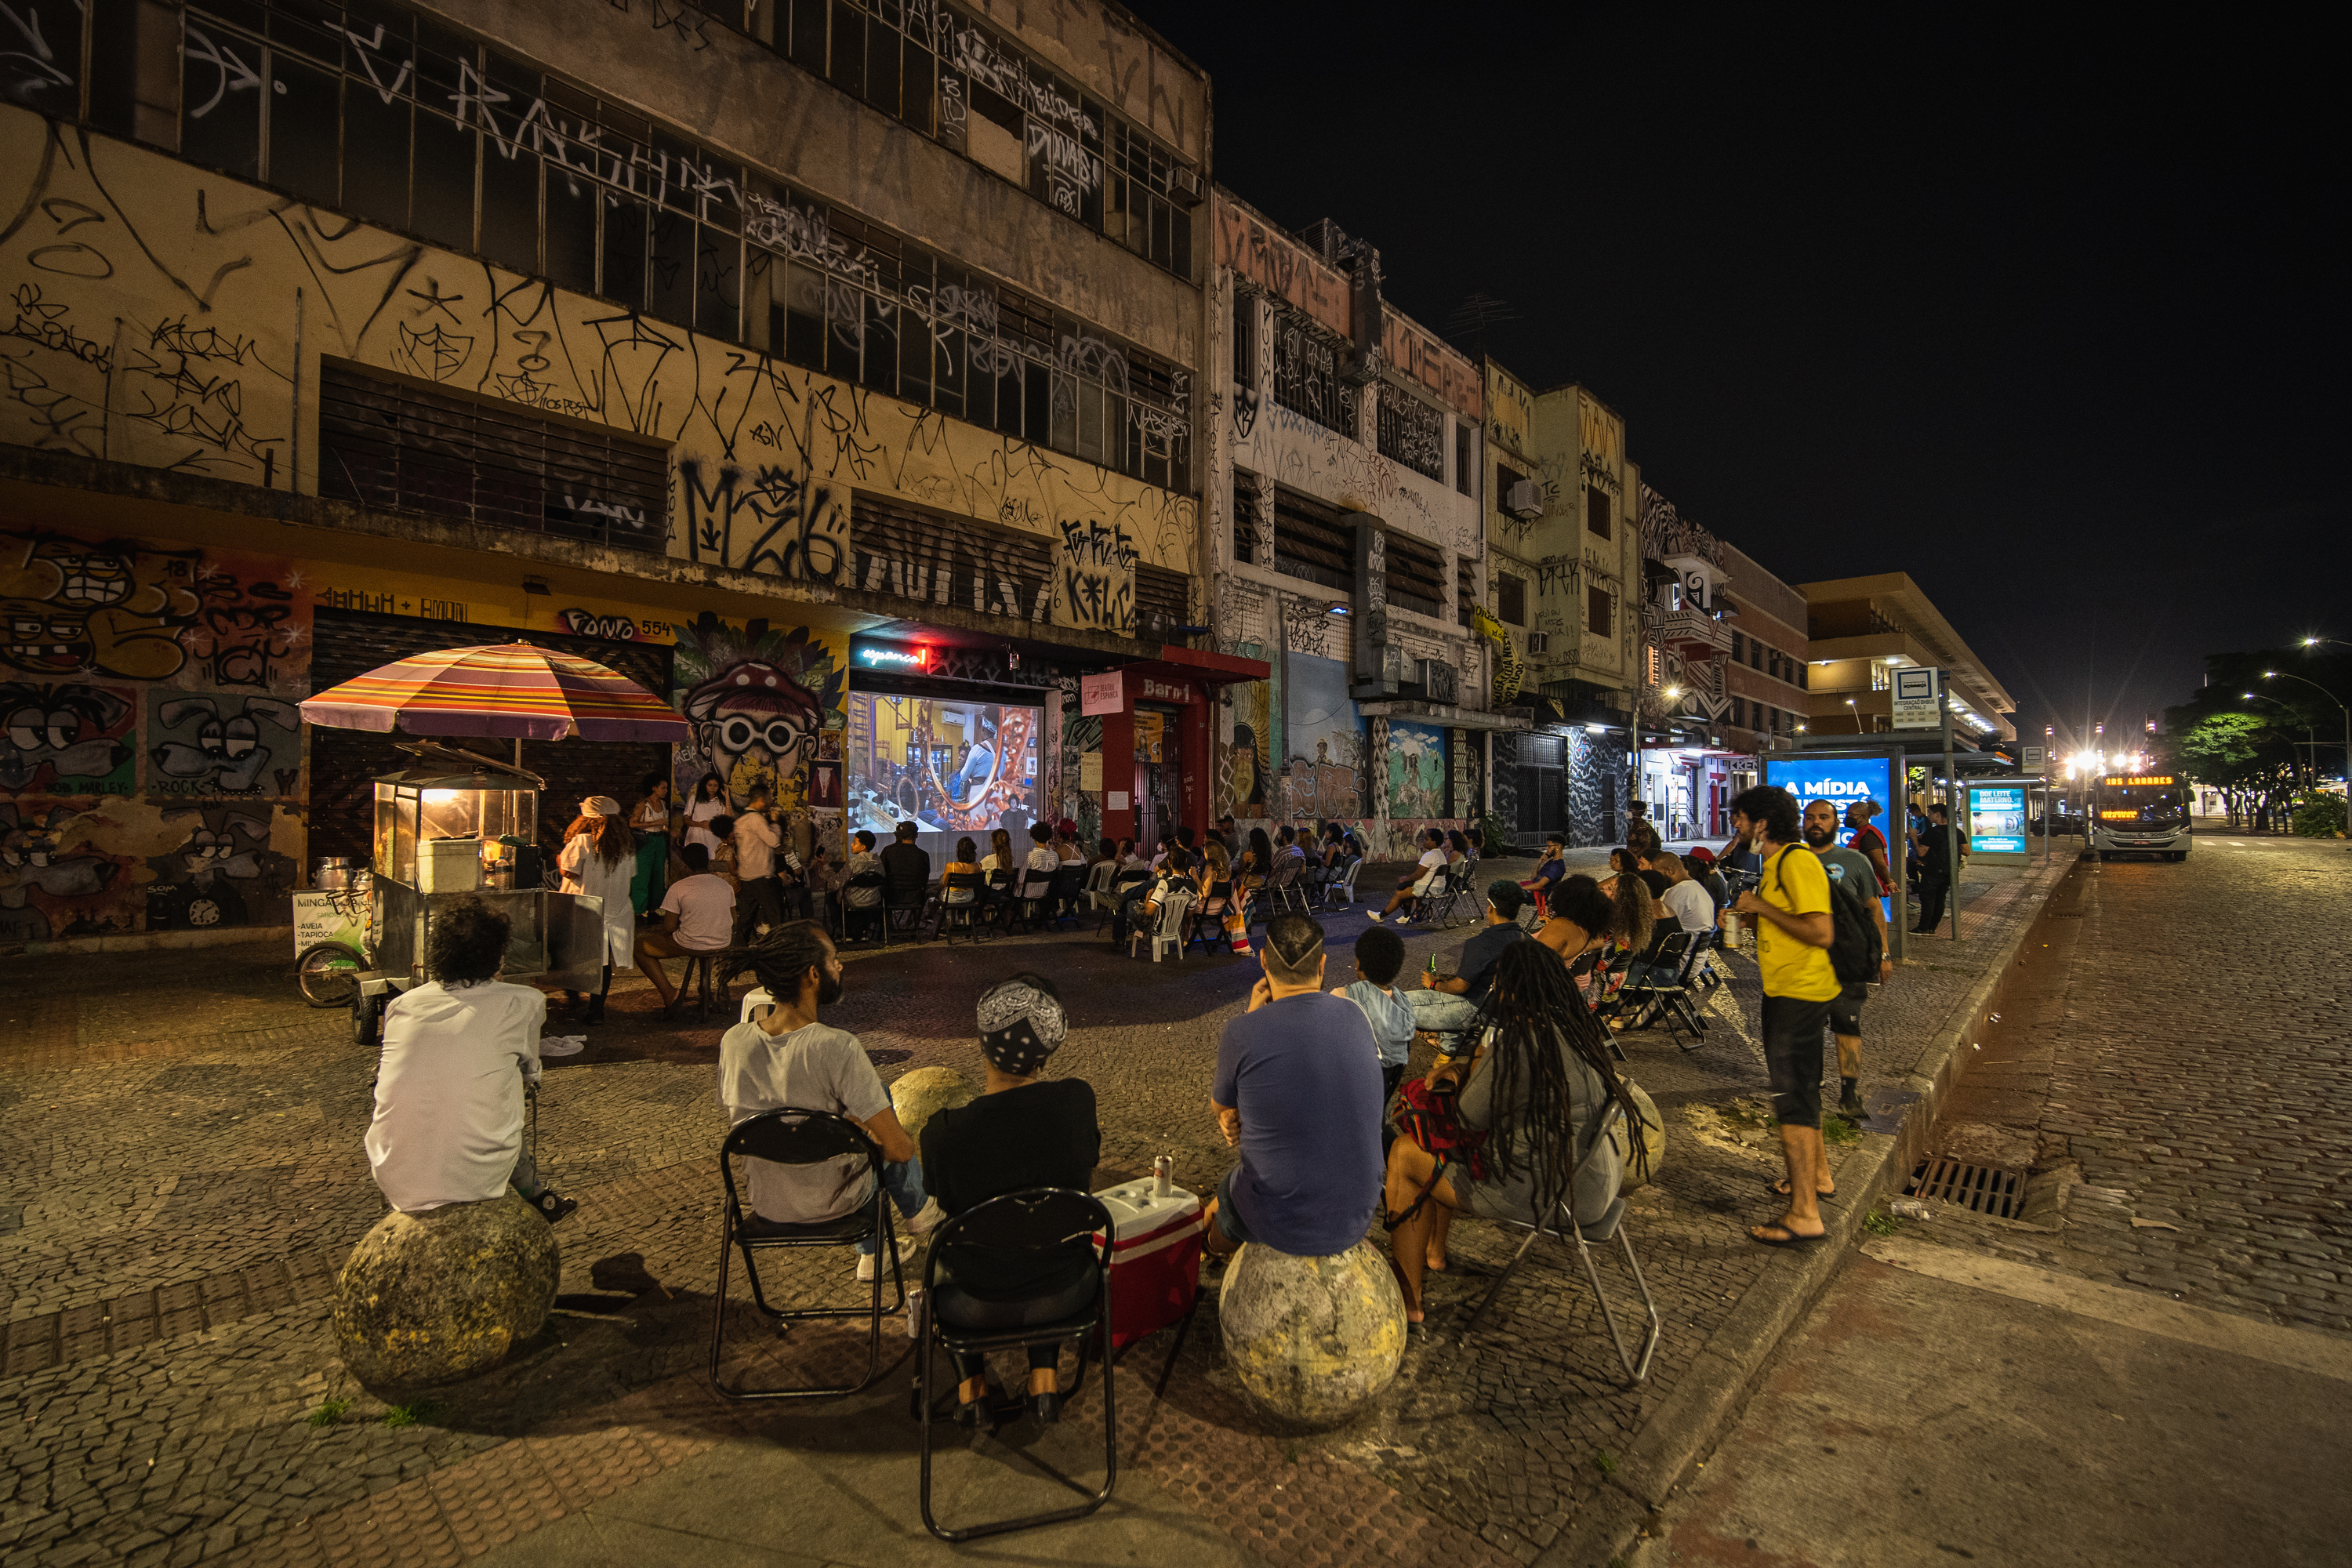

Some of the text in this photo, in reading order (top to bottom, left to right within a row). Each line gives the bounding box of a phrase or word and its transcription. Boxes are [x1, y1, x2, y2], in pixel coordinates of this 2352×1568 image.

[642, 620, 670, 637] 554
[1100, 683, 1115, 692] TEATRO
[1100, 691, 1119, 701] ESPANCA
[2128, 776, 2173, 786] LOURDES
[1785, 778, 1871, 795] A MÍDIA
